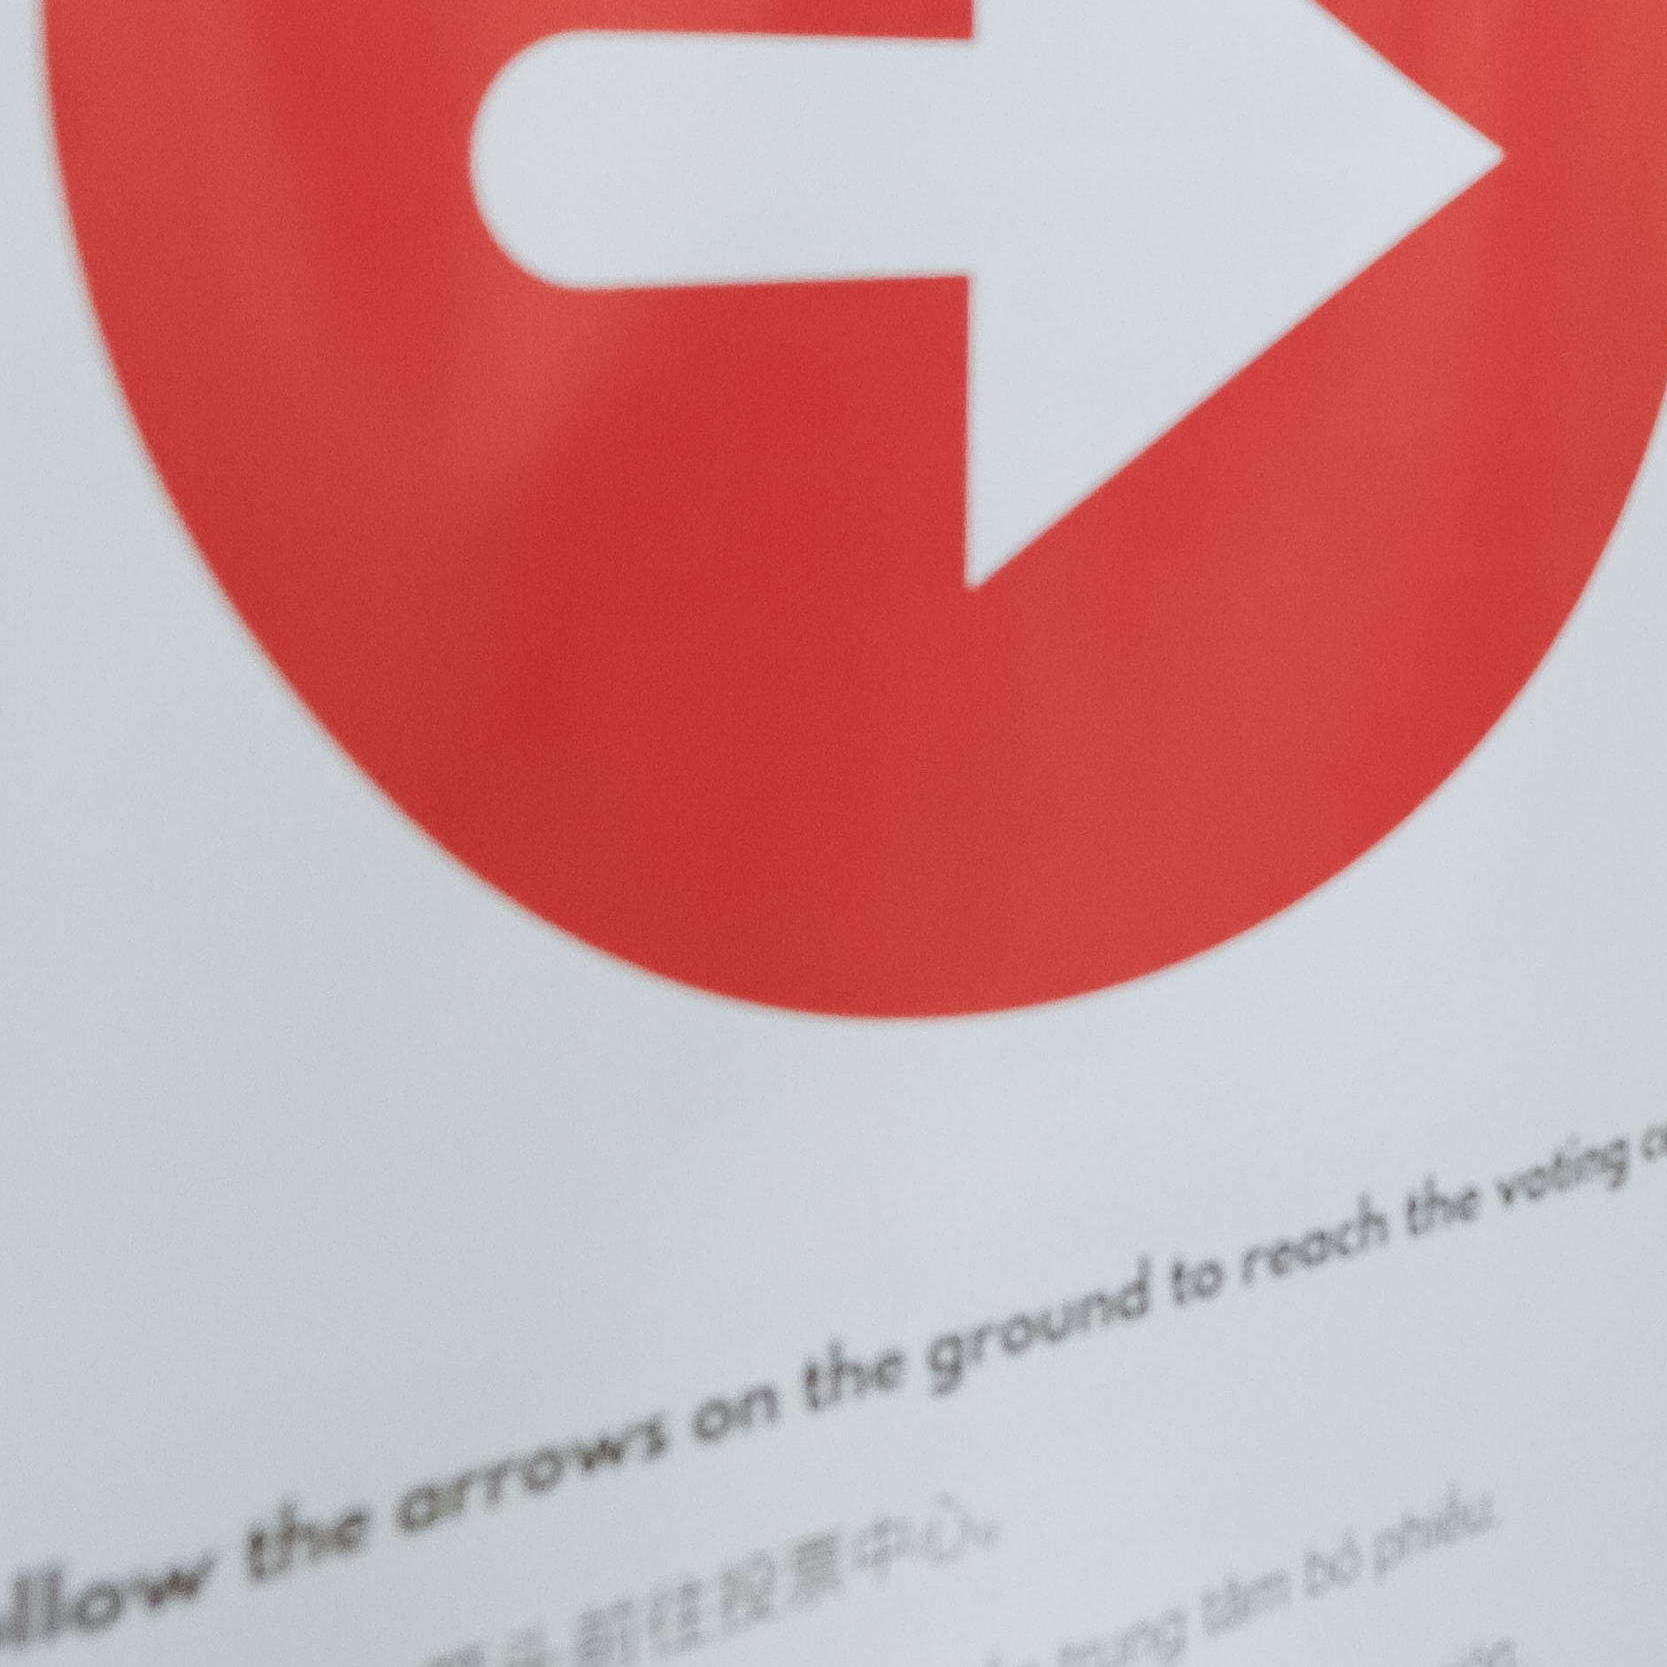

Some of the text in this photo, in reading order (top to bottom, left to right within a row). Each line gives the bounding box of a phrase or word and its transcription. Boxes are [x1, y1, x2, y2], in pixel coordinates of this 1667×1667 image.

[0, 1564, 213, 1650] llow
[245, 1497, 371, 1585] the
[396, 1413, 668, 1535] arrows
[693, 1381, 782, 1449] on
[803, 1338, 908, 1413] the
[926, 1255, 1152, 1395] ground
[1170, 1255, 1225, 1307] to
[1241, 1194, 1389, 1286] reach
[1404, 1174, 1481, 1239] the
[1495, 1135, 1631, 1208] voting
